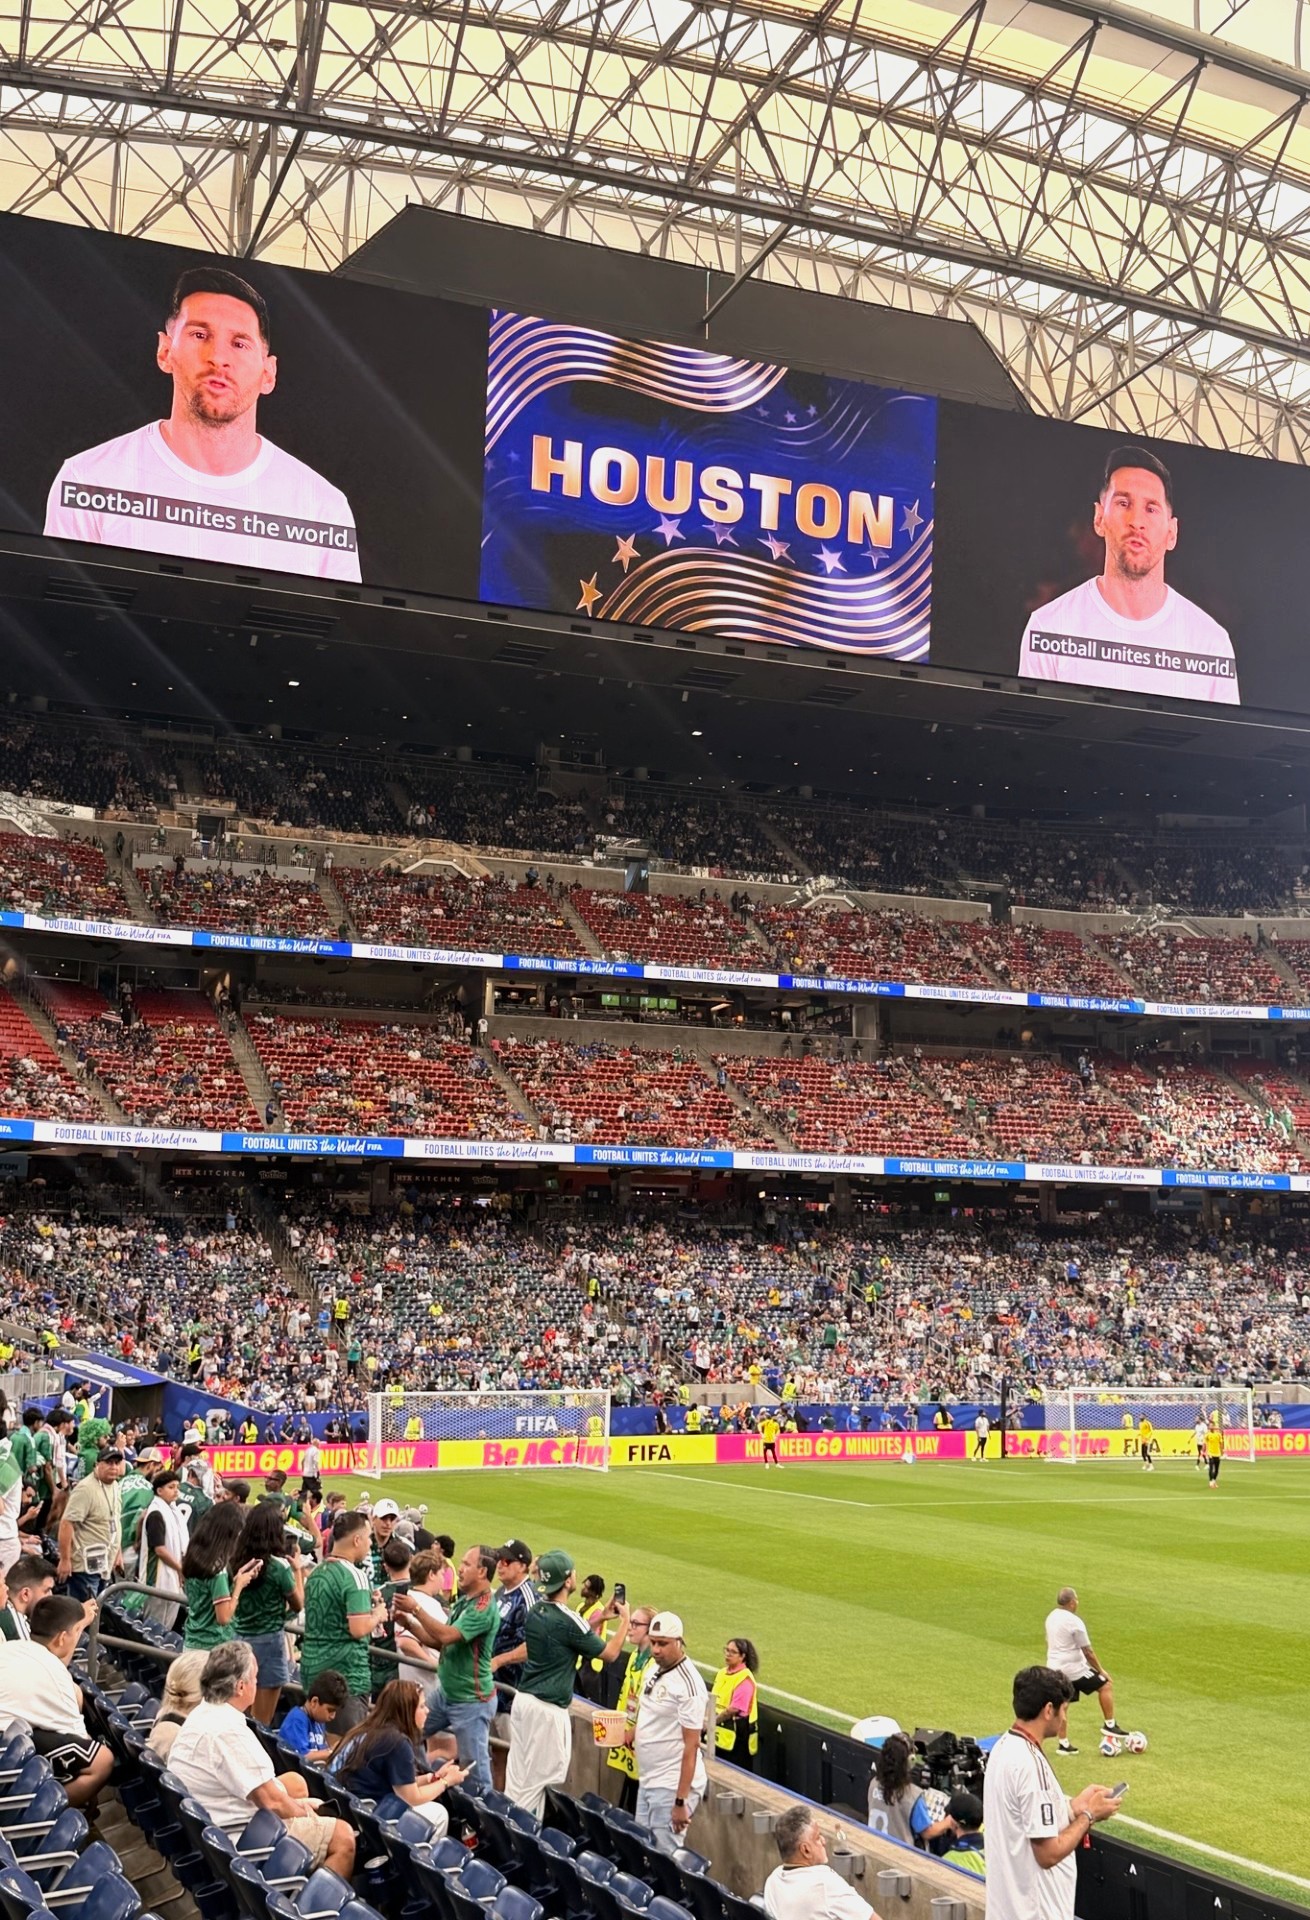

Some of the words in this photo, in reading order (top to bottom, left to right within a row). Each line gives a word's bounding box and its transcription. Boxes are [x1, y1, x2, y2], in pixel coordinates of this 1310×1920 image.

[531, 434, 894, 549] HOUSTON
[62, 485, 158, 518] Football
[165, 505, 236, 529] unites
[243, 514, 280, 537] the
[285, 524, 355, 549] world.
[1031, 634, 1096, 658] Football
[1101, 646, 1151, 665] unites
[1155, 652, 1181, 669] the
[1185, 658, 1234, 677] world.
[45, 919, 82, 932] FOOTBALL
[86, 922, 112, 935] UNITES
[114, 925, 127, 937] the
[130, 927, 154, 939] World
[211, 935, 248, 947] FOOTBALL
[250, 937, 276, 949] UNITES
[279, 938, 291, 949] the
[293, 940, 319, 953] World
[370, 947, 402, 958] FOOTBALL
[407, 949, 430, 960] UNITES
[519, 956, 551, 967] FOOTBALL
[554, 958, 577, 969] UNITES
[660, 967, 689, 977] FOOTBALL
[793, 975, 822, 988] FOOTBALL
[824, 978, 844, 990] UNITES
[920, 985, 947, 995] FOOTBALL
[1041, 996, 1067, 1006] FOOTBALL
[1069, 997, 1088, 1008] UNITES
[1157, 1005, 1184, 1014] FOOTBALL
[0, 1125, 13, 1134] IFA
[55, 1128, 97, 1141] FOOTBALL
[101, 1130, 131, 1142] UNITES
[135, 1132, 150, 1143] the
[152, 1133, 180, 1146] World
[243, 1137, 285, 1150] FOOTBALL
[288, 1138, 317, 1151] UNITES
[320, 1139, 336, 1151] the
[337, 1140, 365, 1154] World
[425, 1144, 464, 1155] FOOTBALL
[467, 1145, 494, 1156] UNITES
[496, 1146, 510, 1157] the
[512, 1147, 537, 1159] World
[593, 1150, 630, 1161] FOOTBALL
[632, 1151, 658, 1162] UNITES
[660, 1152, 674, 1163] the
[675, 1152, 700, 1165] World
[752, 1156, 785, 1167] FOOTBALL
[788, 1157, 812, 1168] UNITES
[195, 1168, 246, 1177] KITCHEN
[900, 1162, 933, 1174] FOOTBALL
[935, 1163, 958, 1175] UNITES
[1041, 1168, 1073, 1178] FOOTBALL
[1075, 1169, 1096, 1179] UNITES
[1176, 1174, 1206, 1184] FOOTBALL
[1208, 1175, 1229, 1185] UNITES
[516, 1416, 558, 1432] FIFA
[780, 1438, 812, 1456] NEED
[815, 1437, 843, 1456] 60
[846, 1437, 902, 1456] MINUTES
[905, 1437, 914, 1455] A
[915, 1436, 940, 1454] DAY
[1124, 1438, 1161, 1454] FIA
[1252, 1433, 1281, 1452] NEED
[1282, 1433, 1306, 1452] 60
[214, 1450, 256, 1473] NEED
[259, 1449, 295, 1472] 60
[297, 1449, 368, 1472] MNUTES
[386, 1447, 416, 1468] DAY
[483, 1442, 519, 1466] Be
[628, 1445, 671, 1462] FIFA
